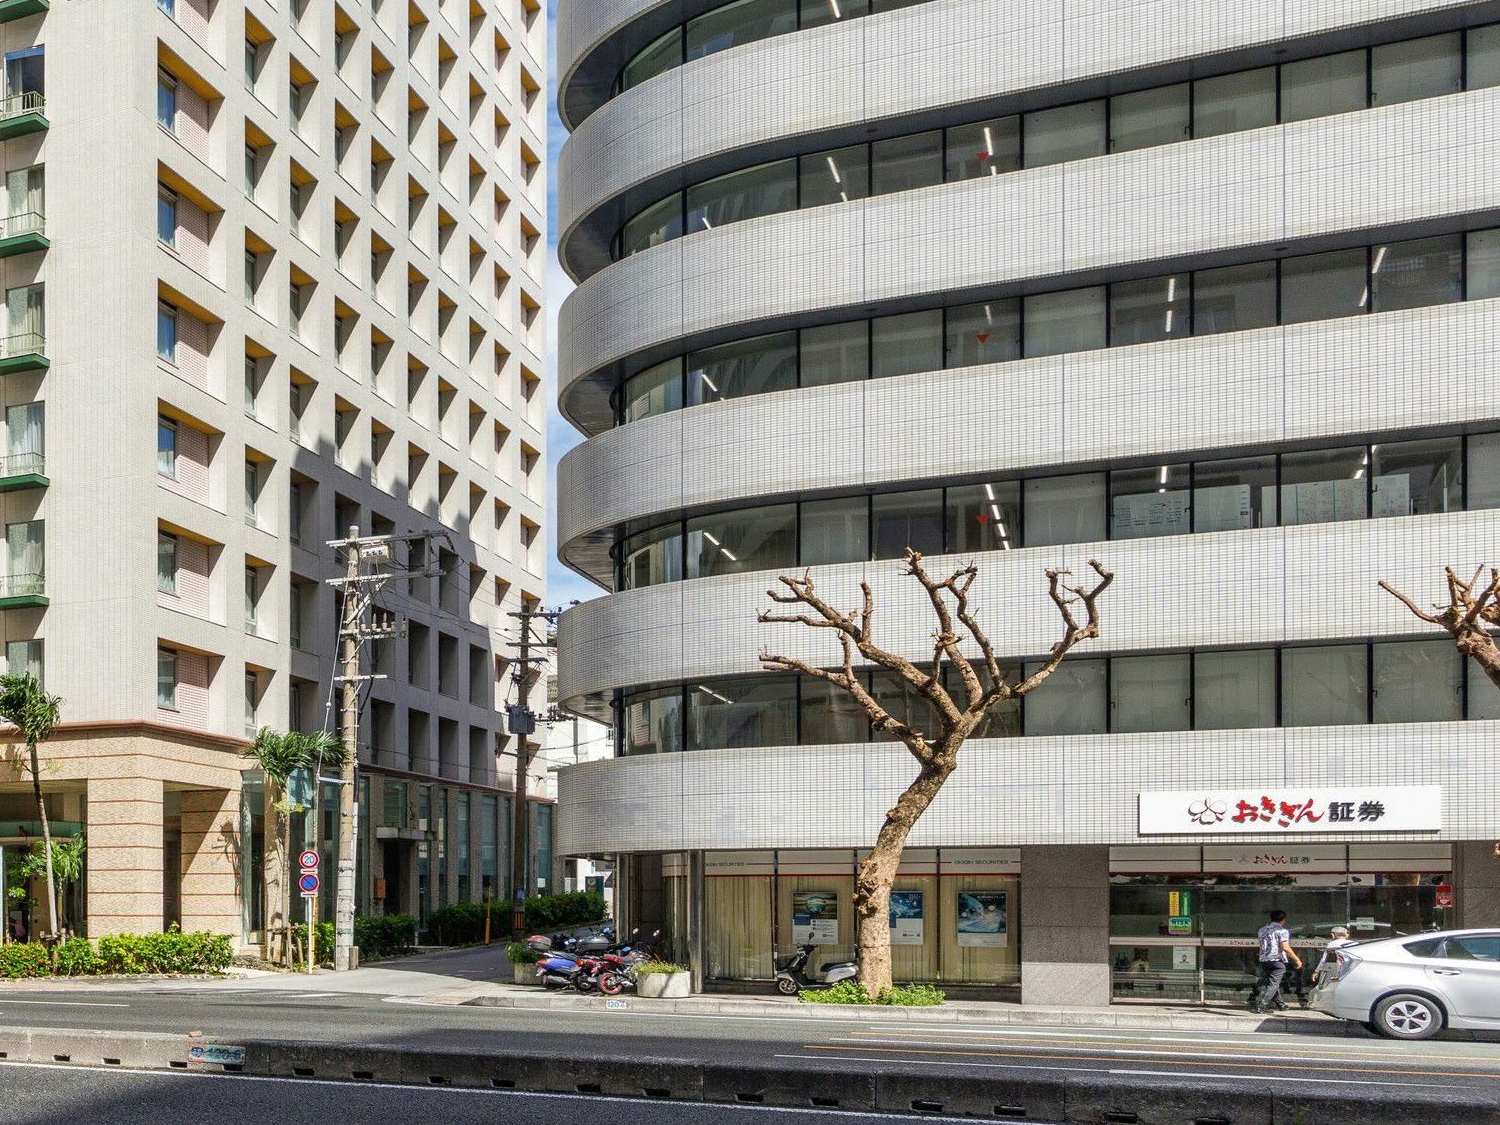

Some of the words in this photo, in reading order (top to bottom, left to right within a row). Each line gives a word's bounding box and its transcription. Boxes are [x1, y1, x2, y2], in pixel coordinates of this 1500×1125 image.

[1232, 795, 1386, 828] おきぎん証券
